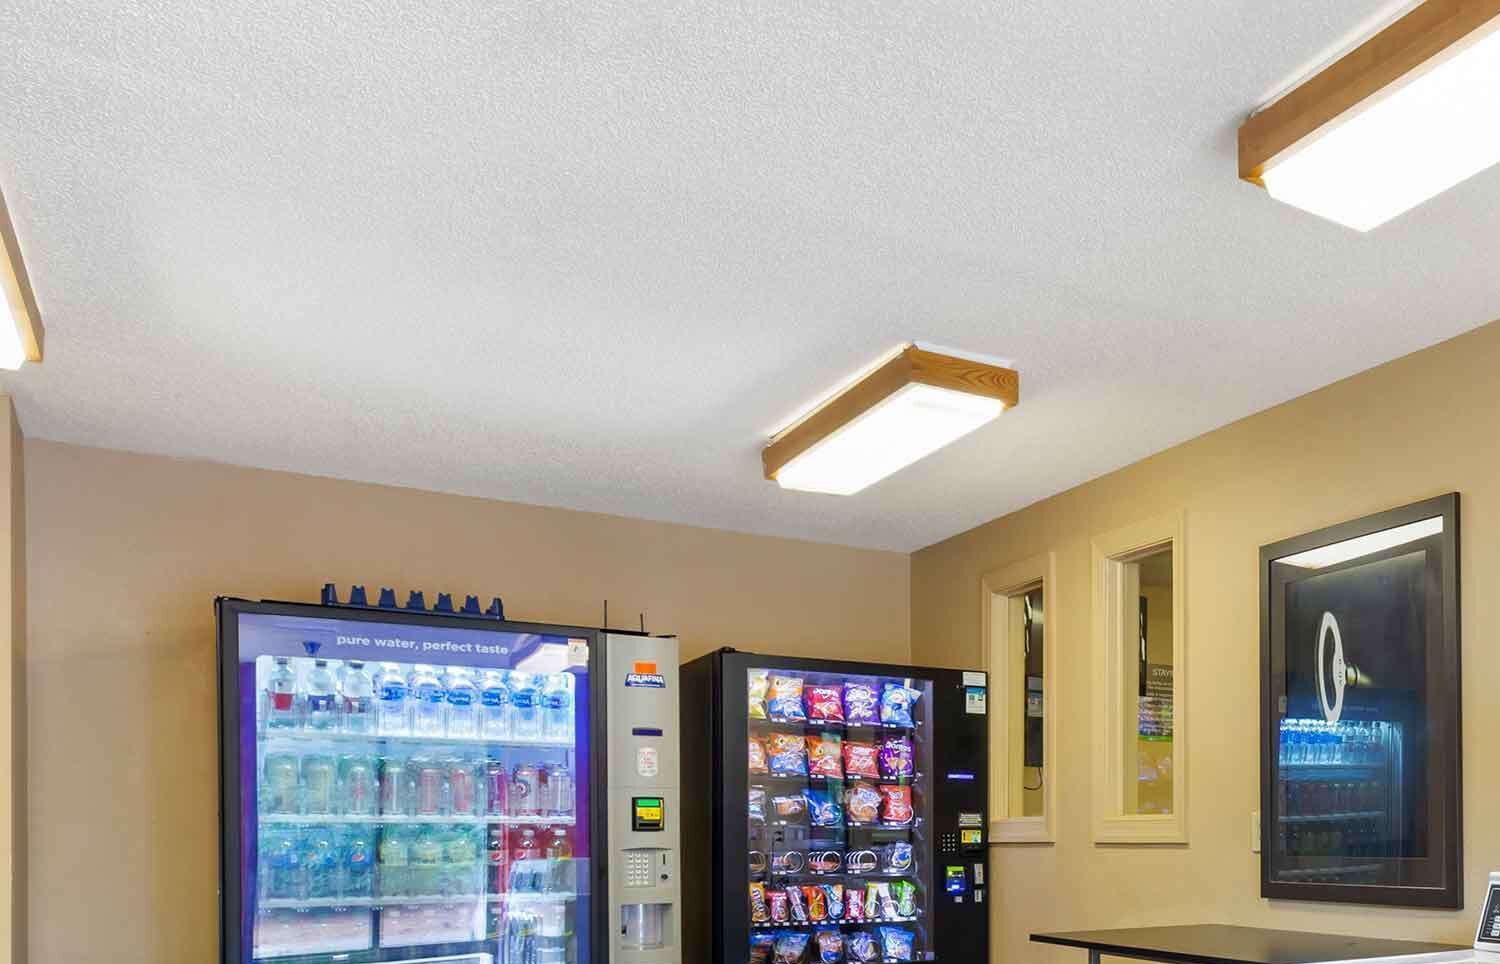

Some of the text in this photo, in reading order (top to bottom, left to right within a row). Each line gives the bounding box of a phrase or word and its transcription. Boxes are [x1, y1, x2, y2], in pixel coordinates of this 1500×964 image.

[336, 635, 509, 655] pure water, perfect taste
